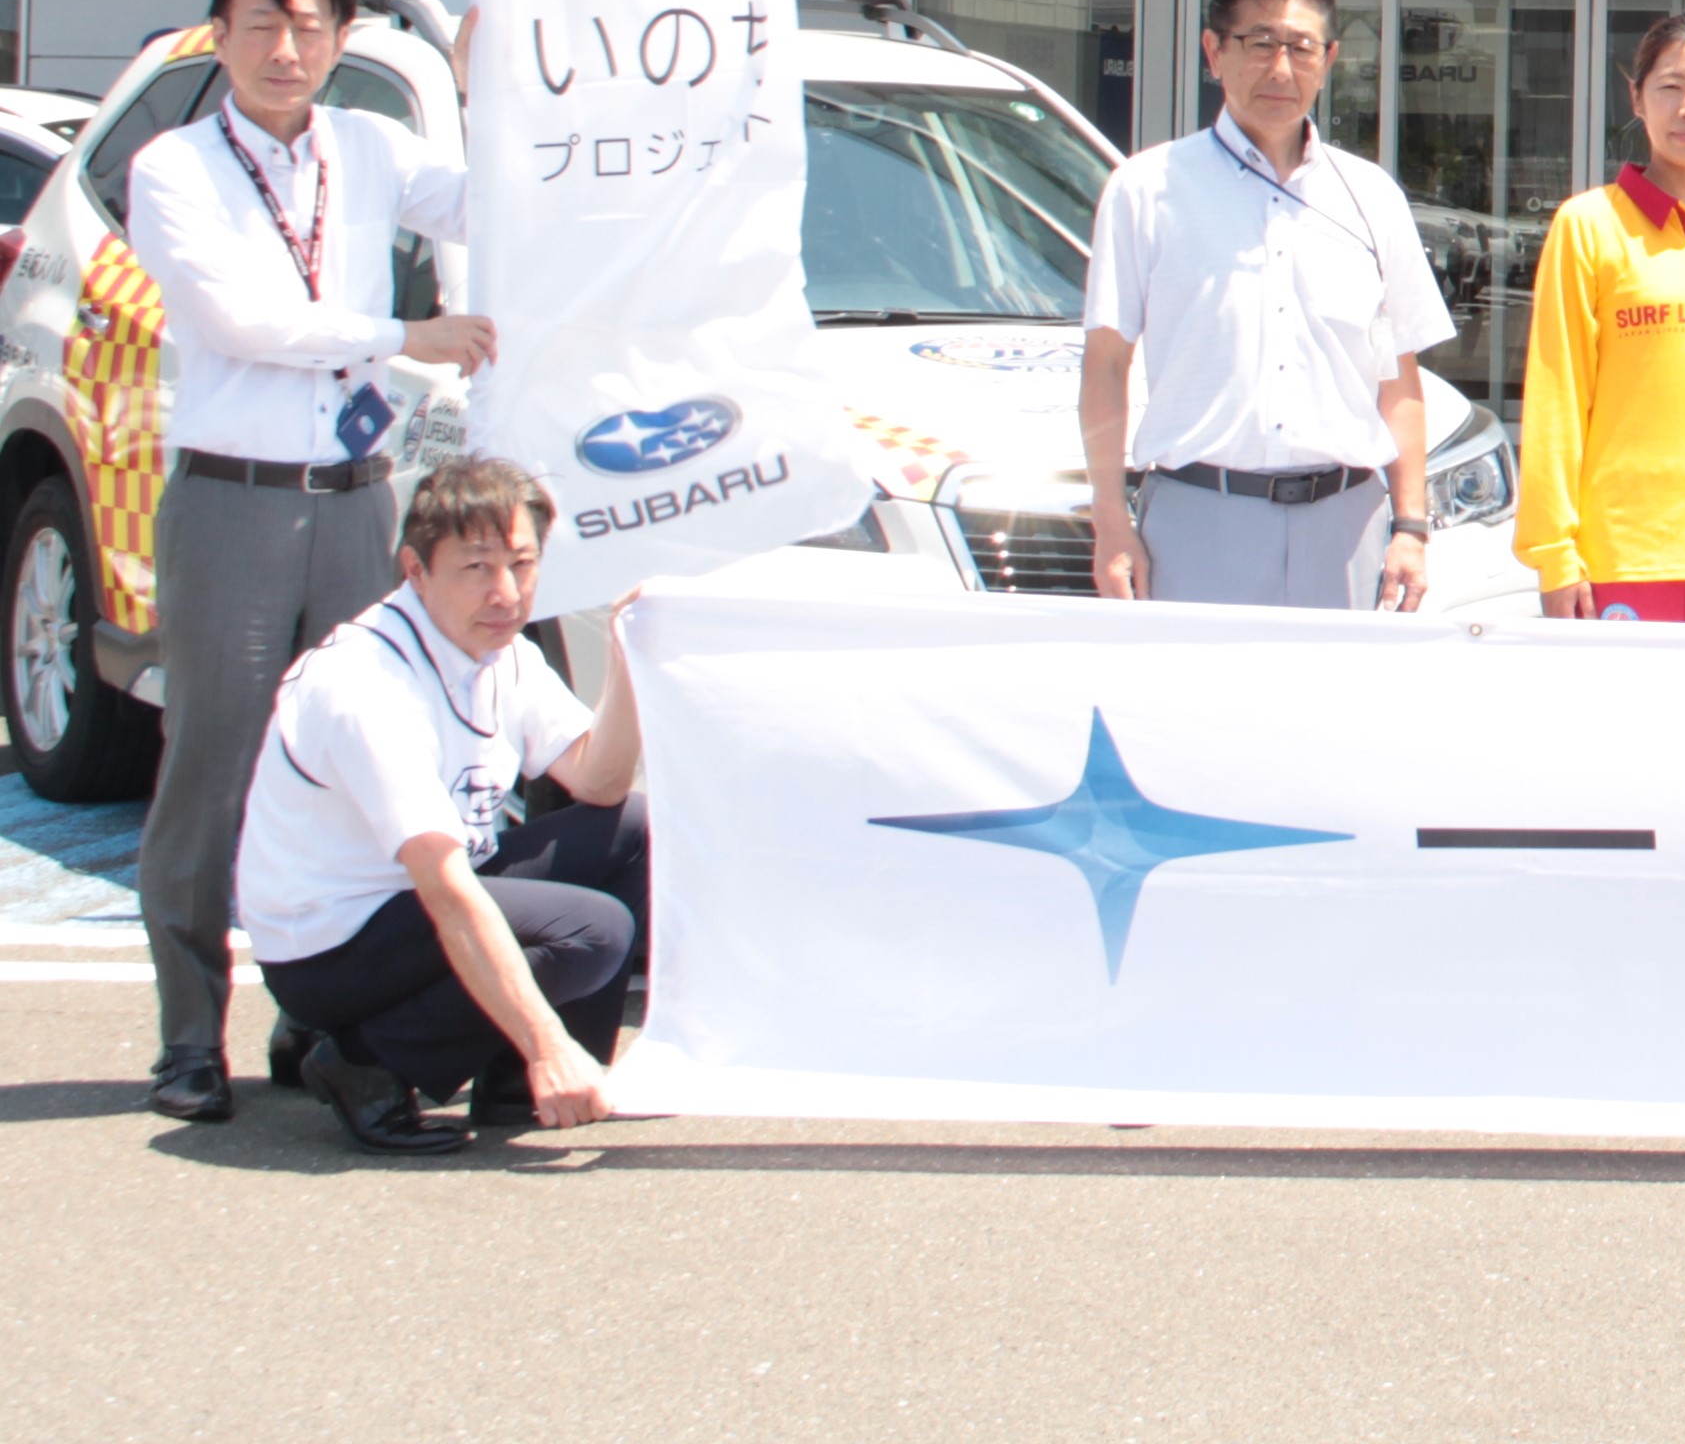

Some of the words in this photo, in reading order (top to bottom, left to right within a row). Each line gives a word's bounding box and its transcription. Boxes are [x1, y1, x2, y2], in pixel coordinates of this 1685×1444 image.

[1359, 63, 1478, 83] SBARU
[534, 114, 771, 182] プロジェト
[1616, 304, 1671, 329] SURF
[575, 452, 790, 540] SUBARU
